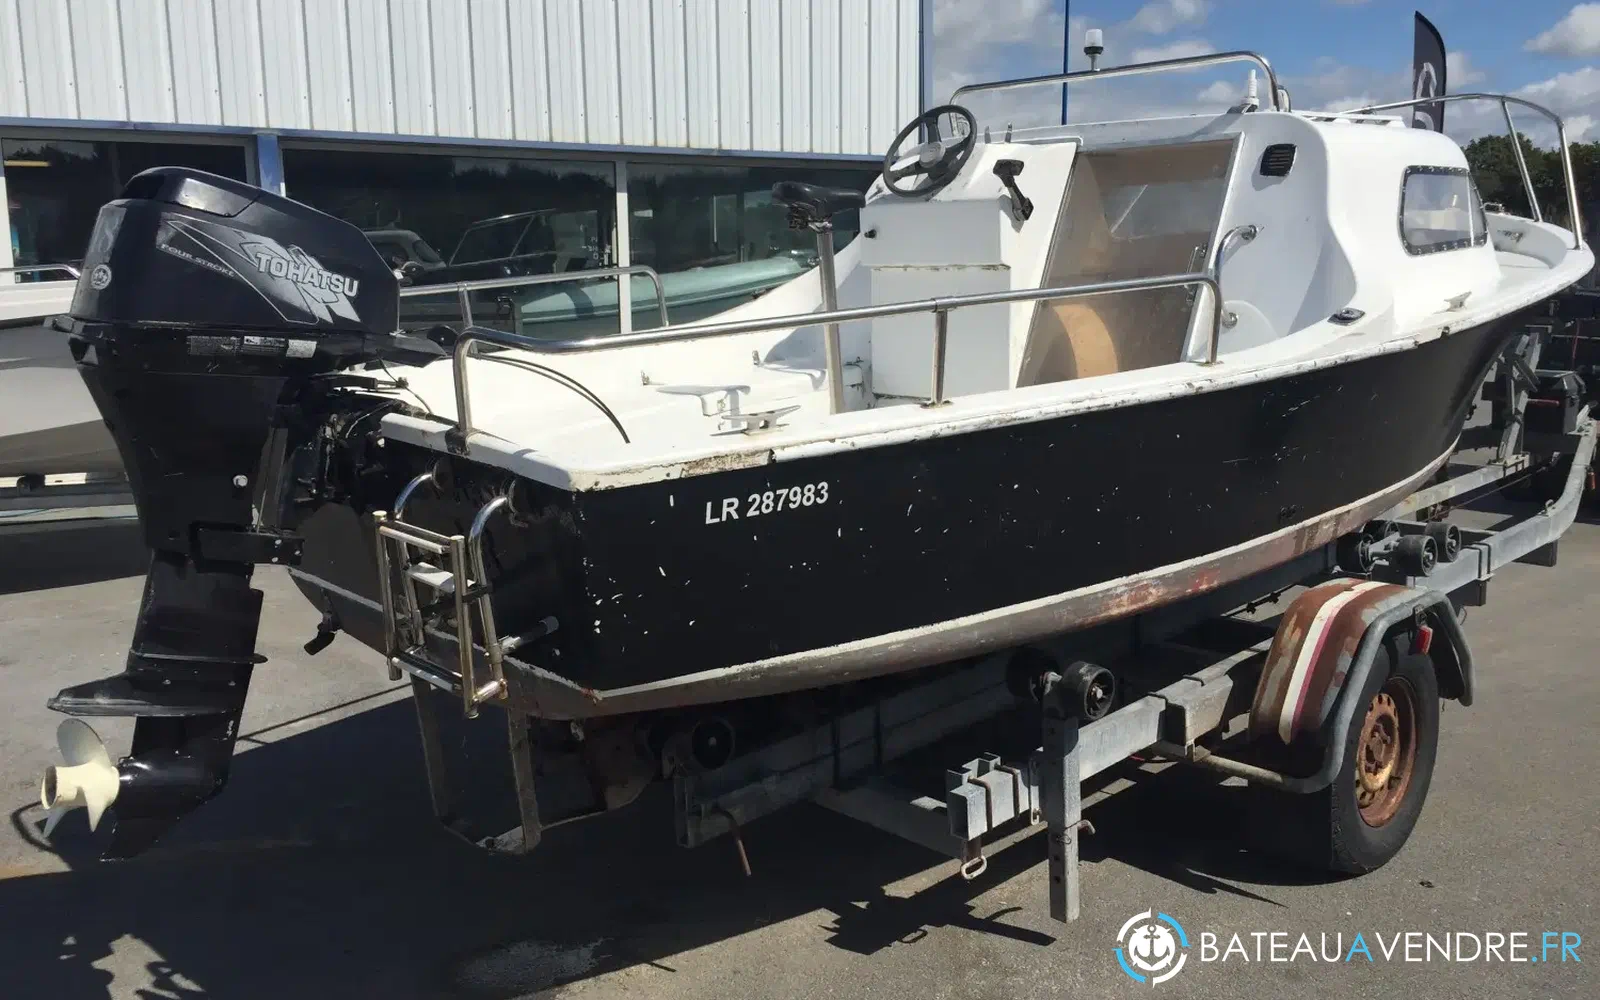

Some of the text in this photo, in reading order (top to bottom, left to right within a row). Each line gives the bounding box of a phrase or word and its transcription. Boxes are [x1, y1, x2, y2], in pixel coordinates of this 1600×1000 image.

[160, 243, 235, 278] FOUR STROKE
[256, 252, 359, 298] TOHATSU
[705, 481, 829, 525] LR 287983
